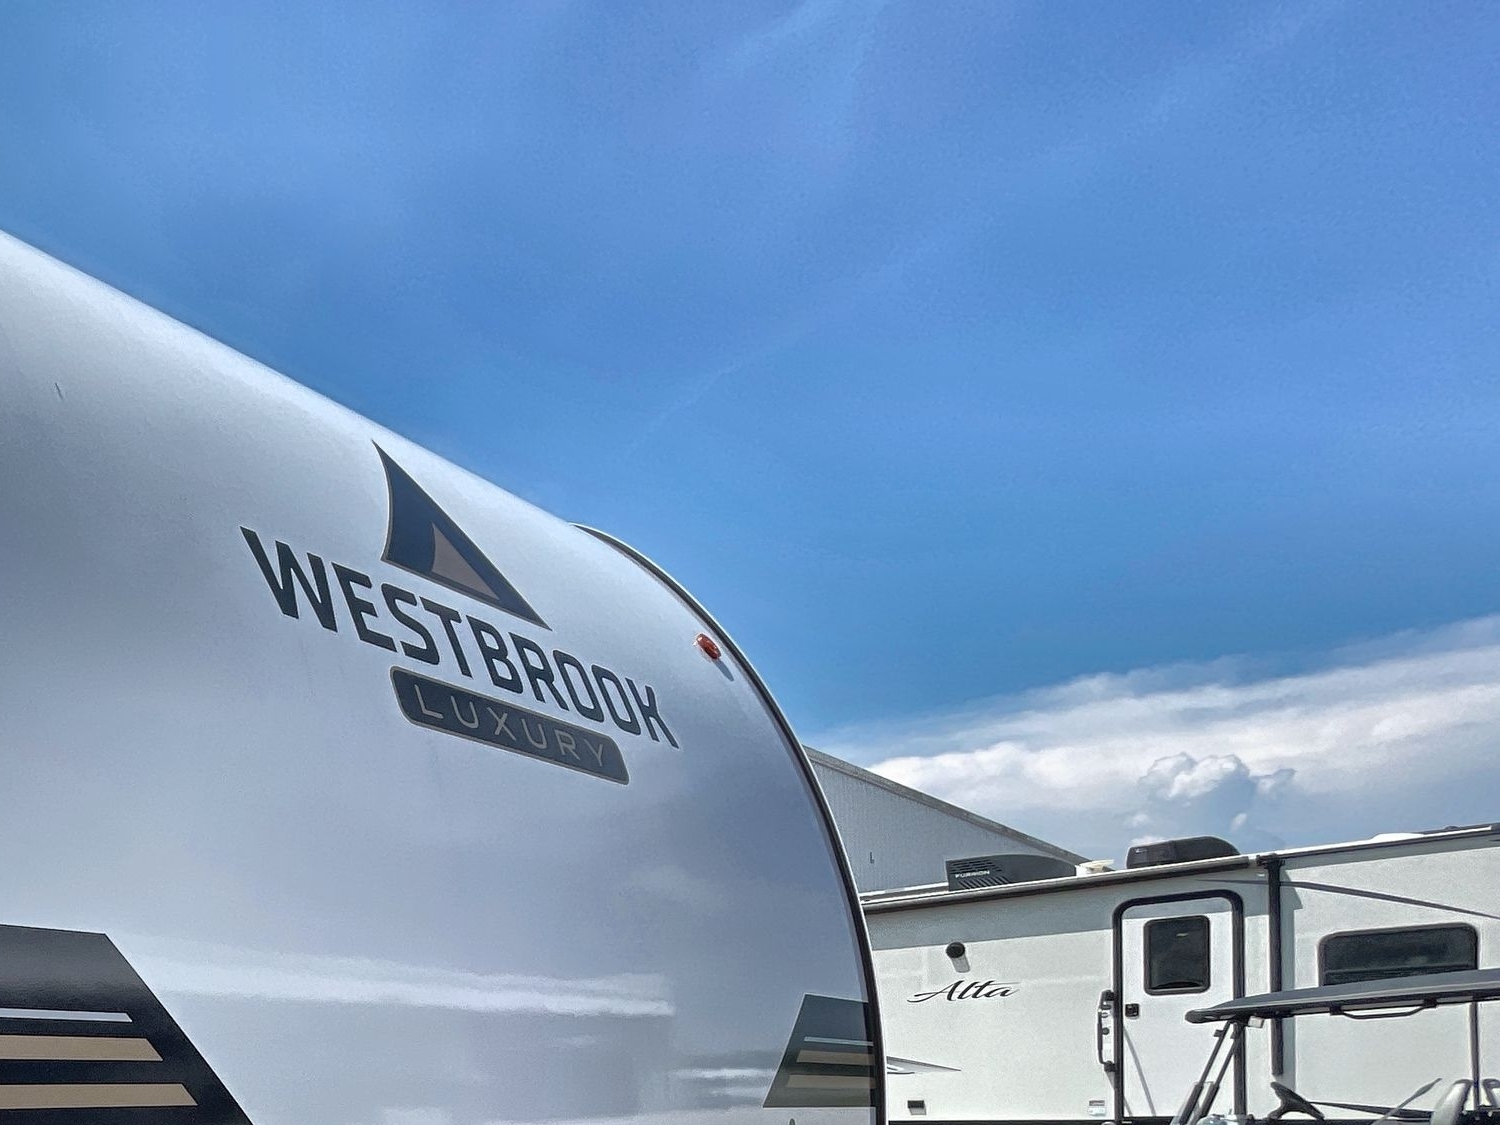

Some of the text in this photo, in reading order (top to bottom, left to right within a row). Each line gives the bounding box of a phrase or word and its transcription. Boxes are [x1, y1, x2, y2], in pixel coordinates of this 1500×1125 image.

[238, 525, 680, 750] WESTBROOK
[414, 683, 606, 768] LUXURY
[907, 979, 1021, 1002] Alta
